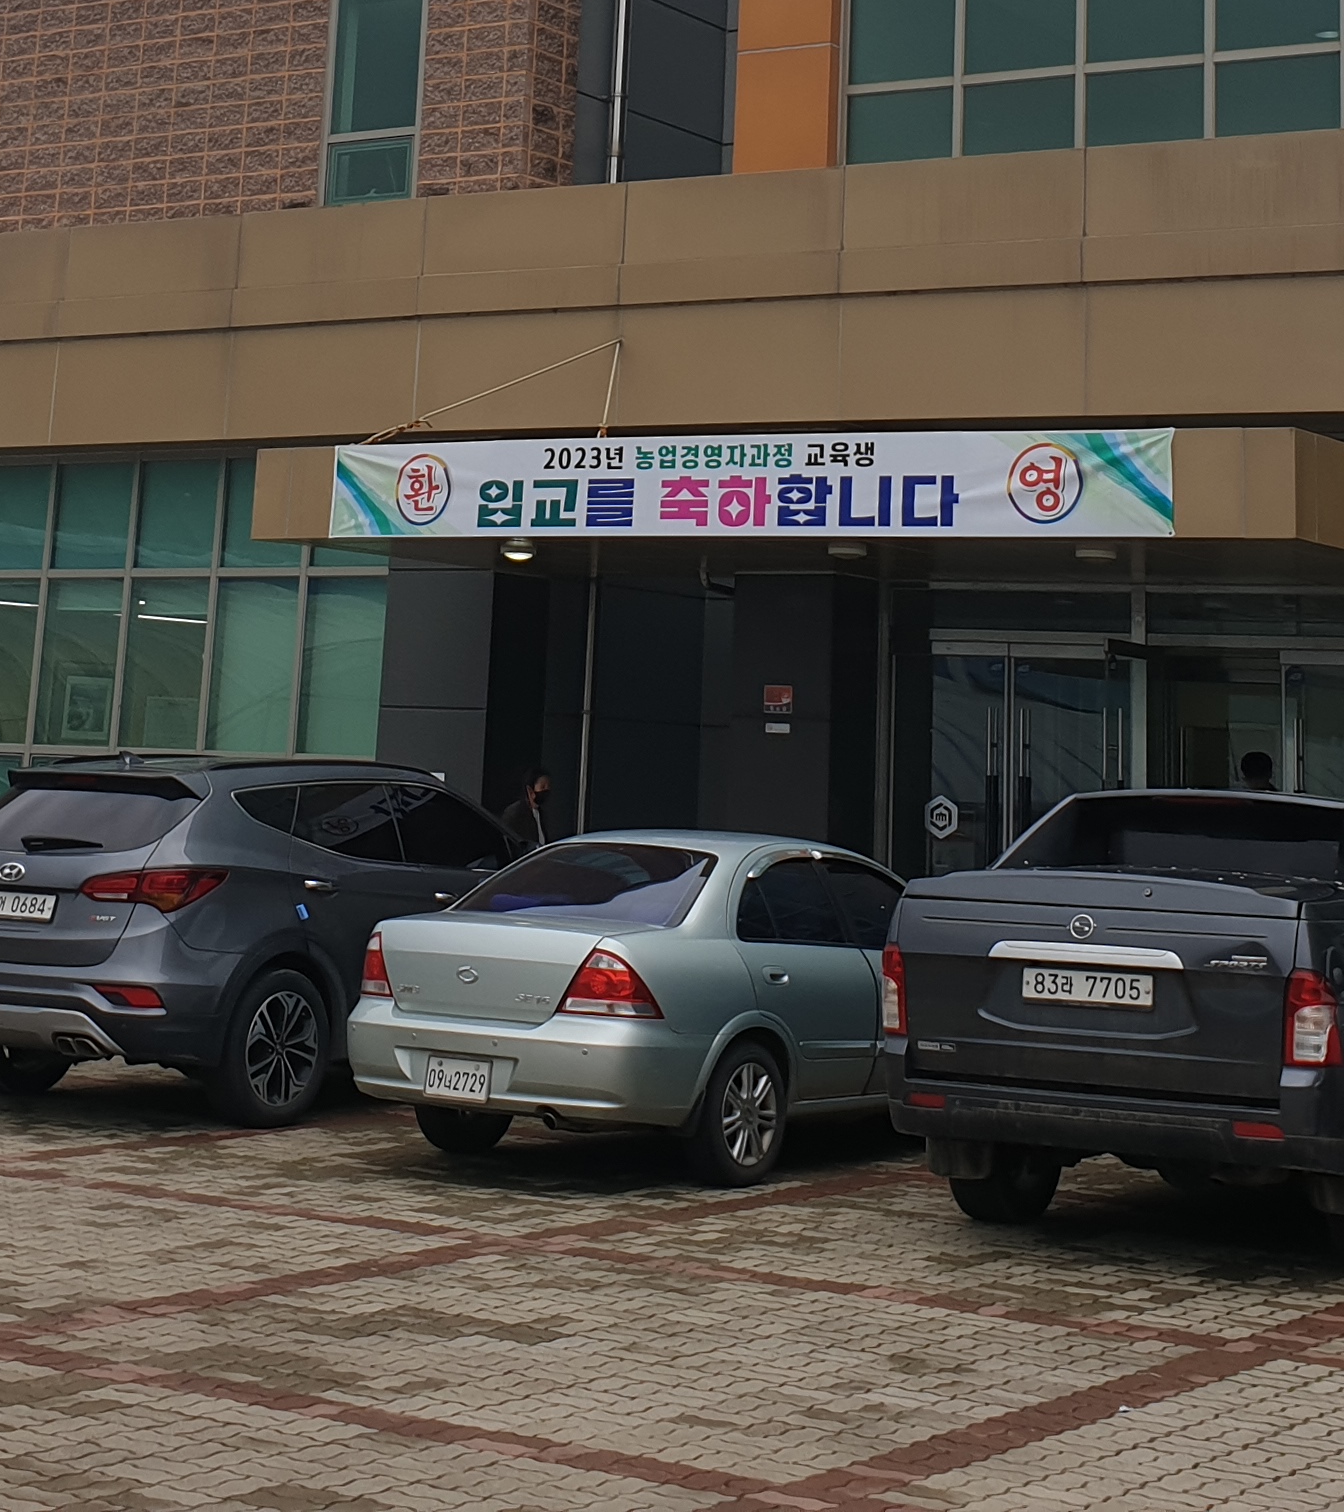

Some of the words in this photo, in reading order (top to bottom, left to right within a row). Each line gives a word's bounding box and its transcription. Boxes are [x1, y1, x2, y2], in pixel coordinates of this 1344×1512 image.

[543, 446, 624, 470] 2023년
[635, 442, 794, 470] 농업경영자과정
[805, 441, 875, 467] 교육생
[403, 464, 440, 512] 환
[477, 477, 635, 528] 입교를
[659, 474, 959, 527] 축하합니다
[1018, 454, 1063, 512] 영
[11, 895, 47, 915] 0684
[1033, 972, 1073, 996] 83라
[1085, 975, 1141, 1000] 7705
